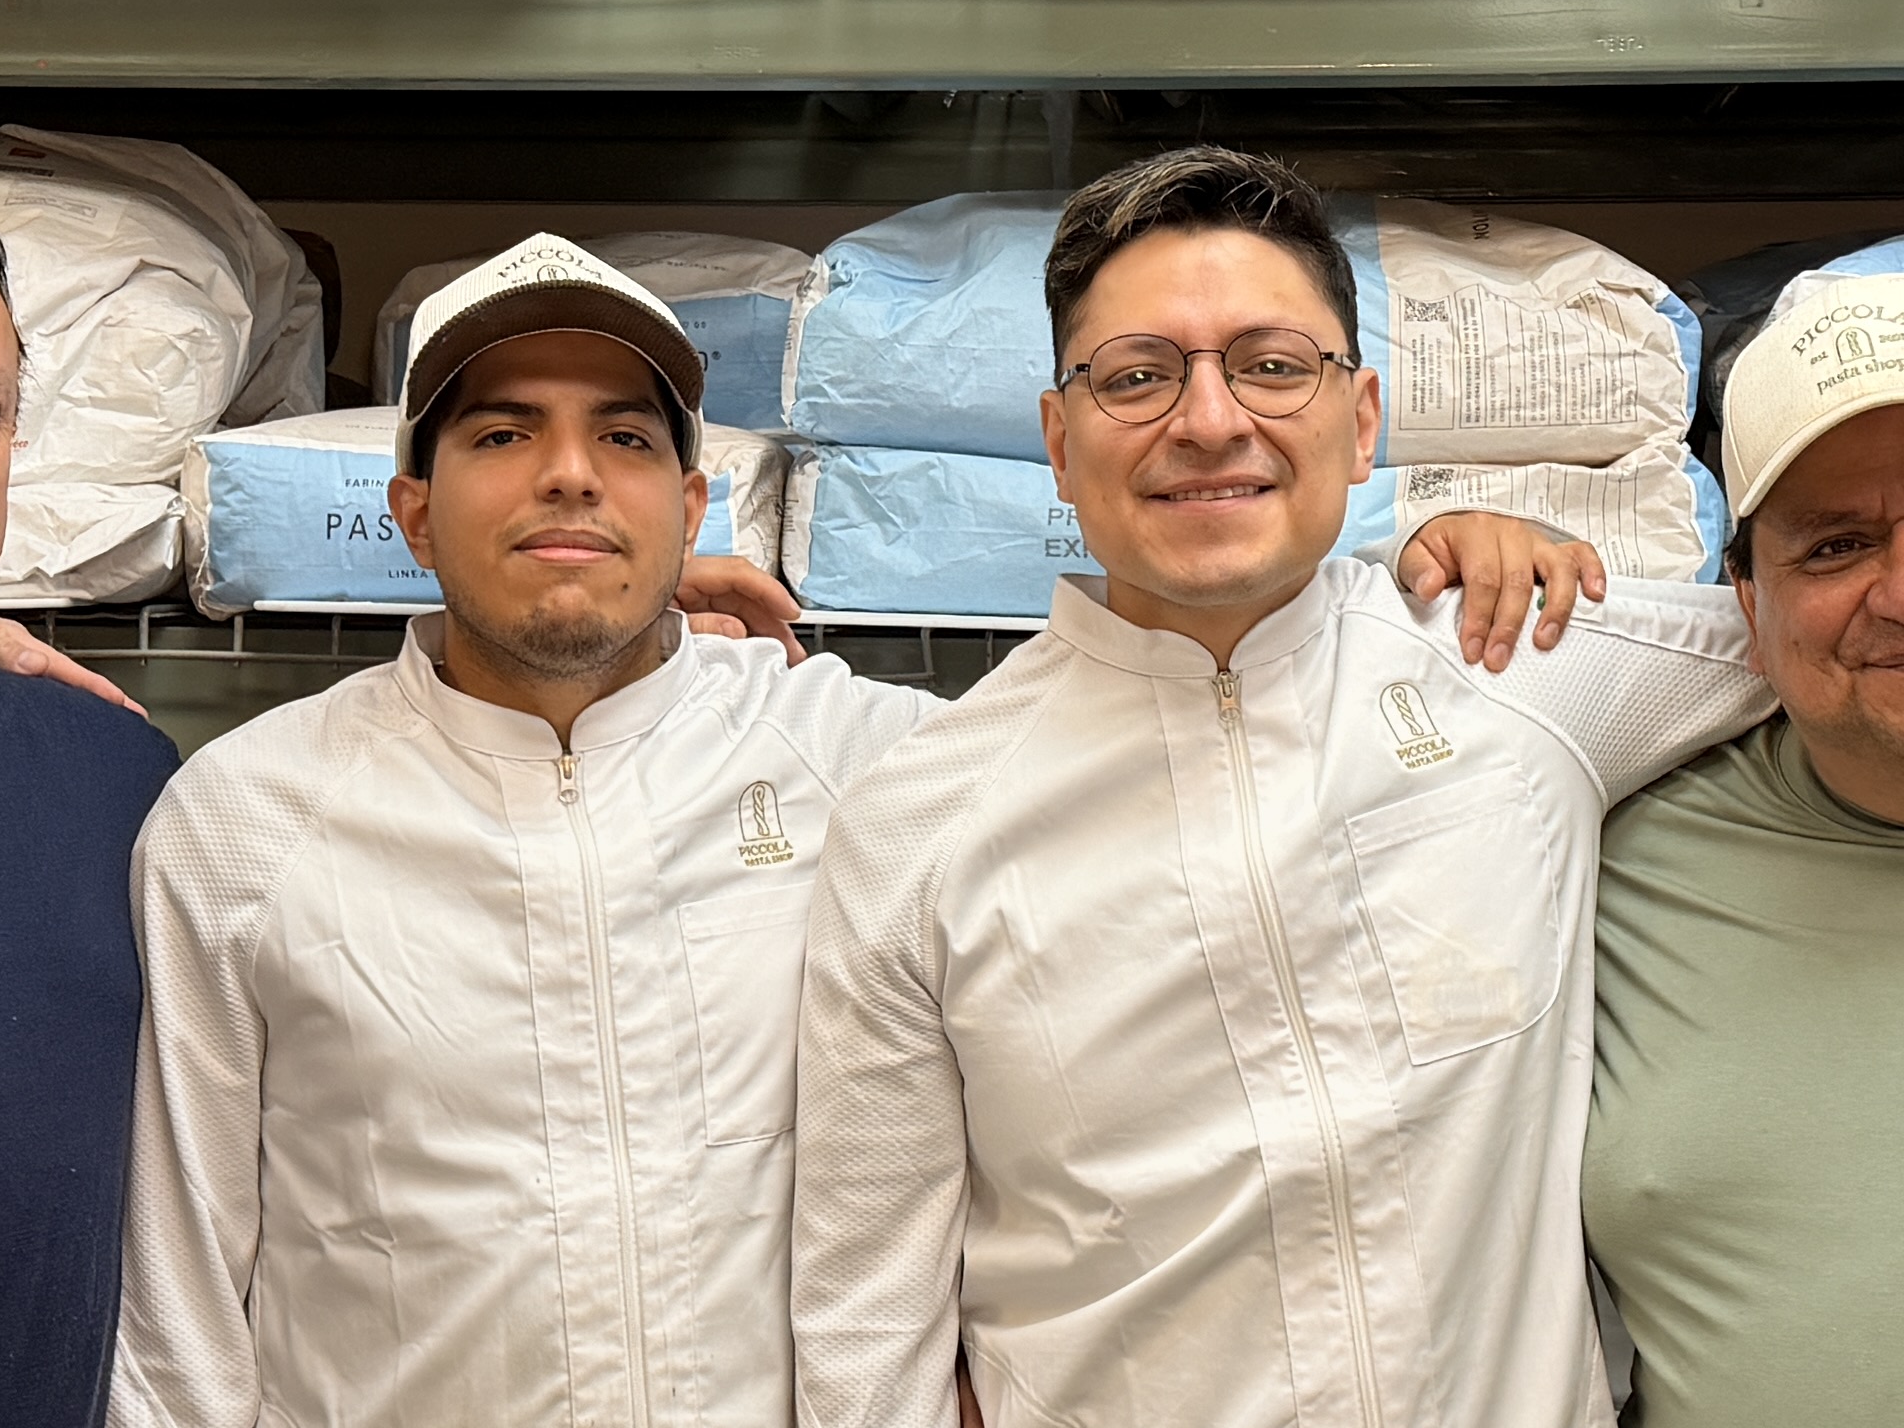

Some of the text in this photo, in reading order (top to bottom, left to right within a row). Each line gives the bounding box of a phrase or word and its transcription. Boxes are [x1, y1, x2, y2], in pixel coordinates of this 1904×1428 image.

[1817, 366, 1862, 396] pasta
[345, 479, 384, 488] FARIN
[327, 513, 393, 541] PAS
[388, 570, 428, 579] LINEA
[1396, 737, 1451, 761] PICCOLA
[738, 840, 793, 857] PICCOLA
